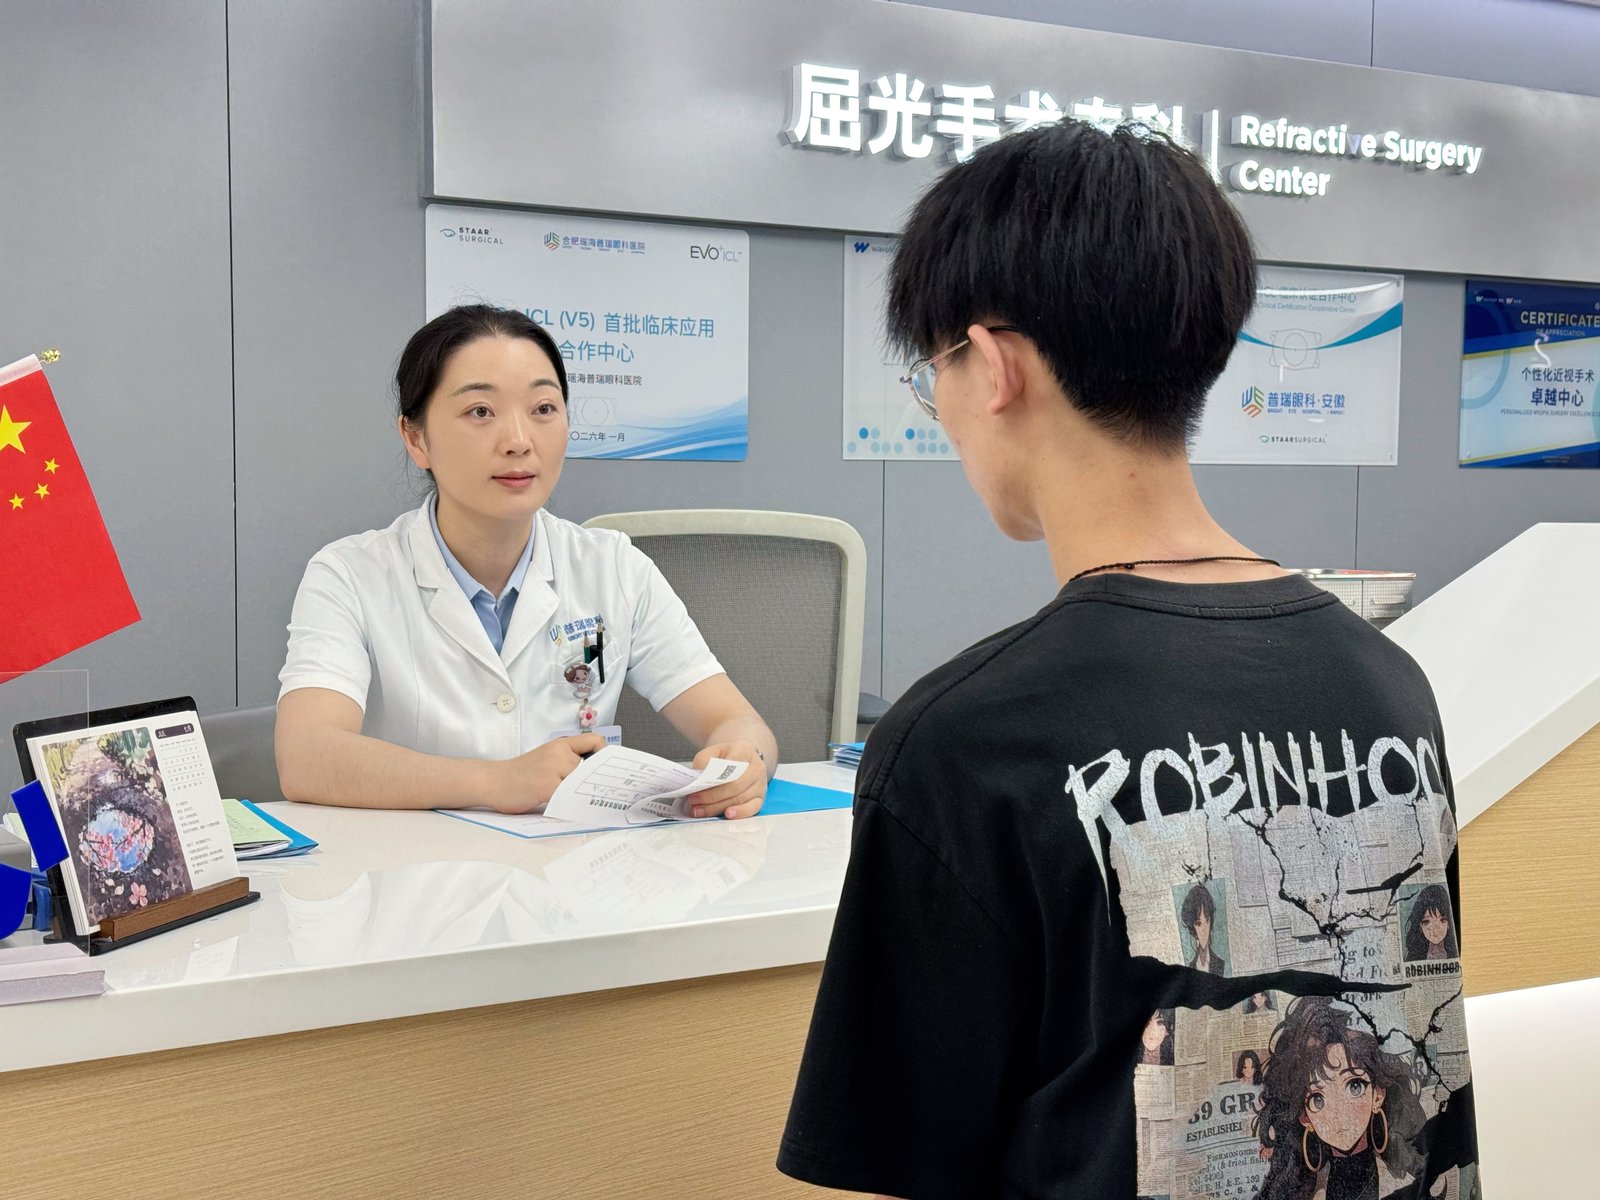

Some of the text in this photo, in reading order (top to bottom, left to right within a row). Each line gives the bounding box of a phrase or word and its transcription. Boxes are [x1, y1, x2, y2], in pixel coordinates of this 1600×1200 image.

[1240, 114, 1482, 174] Refractive Surgery
[1238, 159, 1331, 196] Center
[458, 227, 489, 236] STAAR
[459, 234, 504, 245] SURGICAL
[559, 310, 595, 332] (V5)
[603, 312, 715, 339] 首批临床应用
[1520, 311, 1600, 328] CERTIFICATE
[558, 339, 635, 363] 合作中心
[567, 372, 643, 386] 瑶海普瑞眼科医院
[1521, 367, 1595, 384] 个性化近视手术
[1530, 386, 1584, 407] 卓越中心
[568, 430, 626, 442] 〇二六年一月
[1405, 963, 1460, 979] ROBINHOOD
